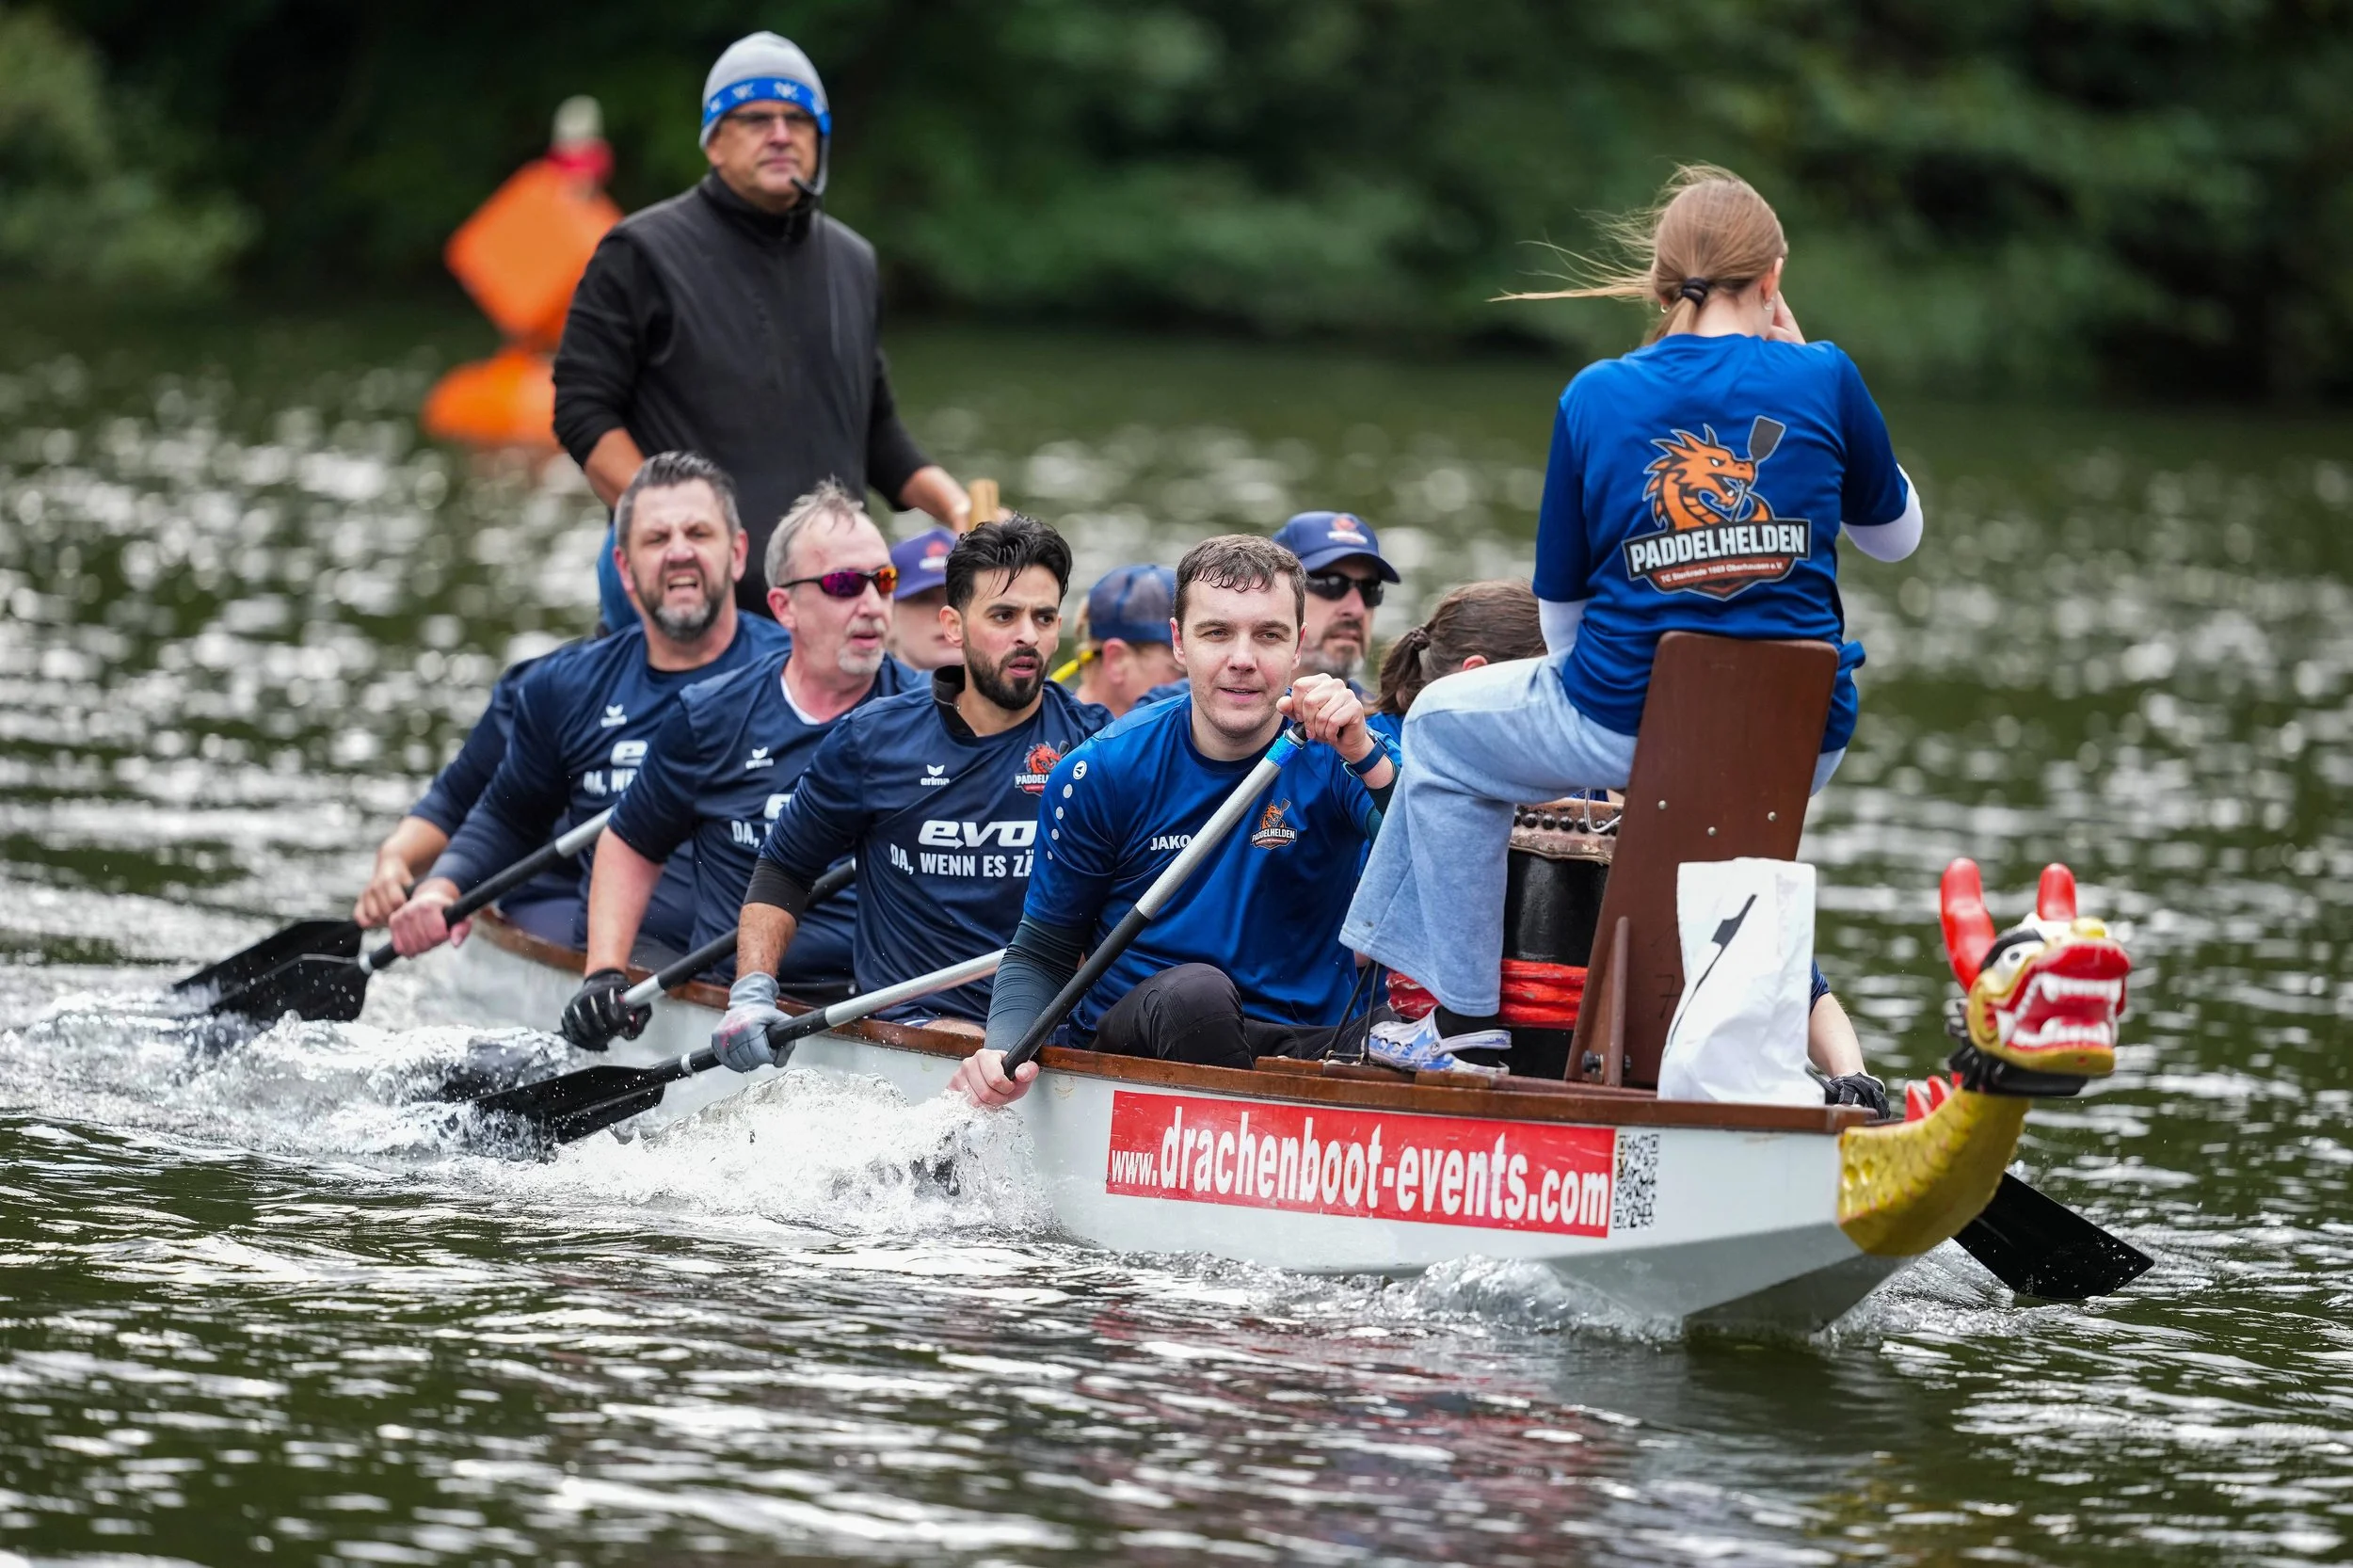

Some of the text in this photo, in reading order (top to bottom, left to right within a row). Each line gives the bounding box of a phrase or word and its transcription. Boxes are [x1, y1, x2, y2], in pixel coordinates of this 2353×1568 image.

[1629, 524, 1805, 573] PADDELHELDEN
[1659, 573, 1673, 584] TC
[1726, 563, 1770, 572] Oberhausen
[731, 820, 760, 848] DA,
[918, 820, 1038, 850] evo
[1150, 834, 1192, 851] JAKO
[1252, 828, 1295, 842] PADDELHELDEN
[890, 842, 914, 875] DA,
[920, 852, 975, 877] WENN
[983, 855, 1007, 877] ES
[1112, 1105, 1609, 1227] www.drachenboot-events.com
